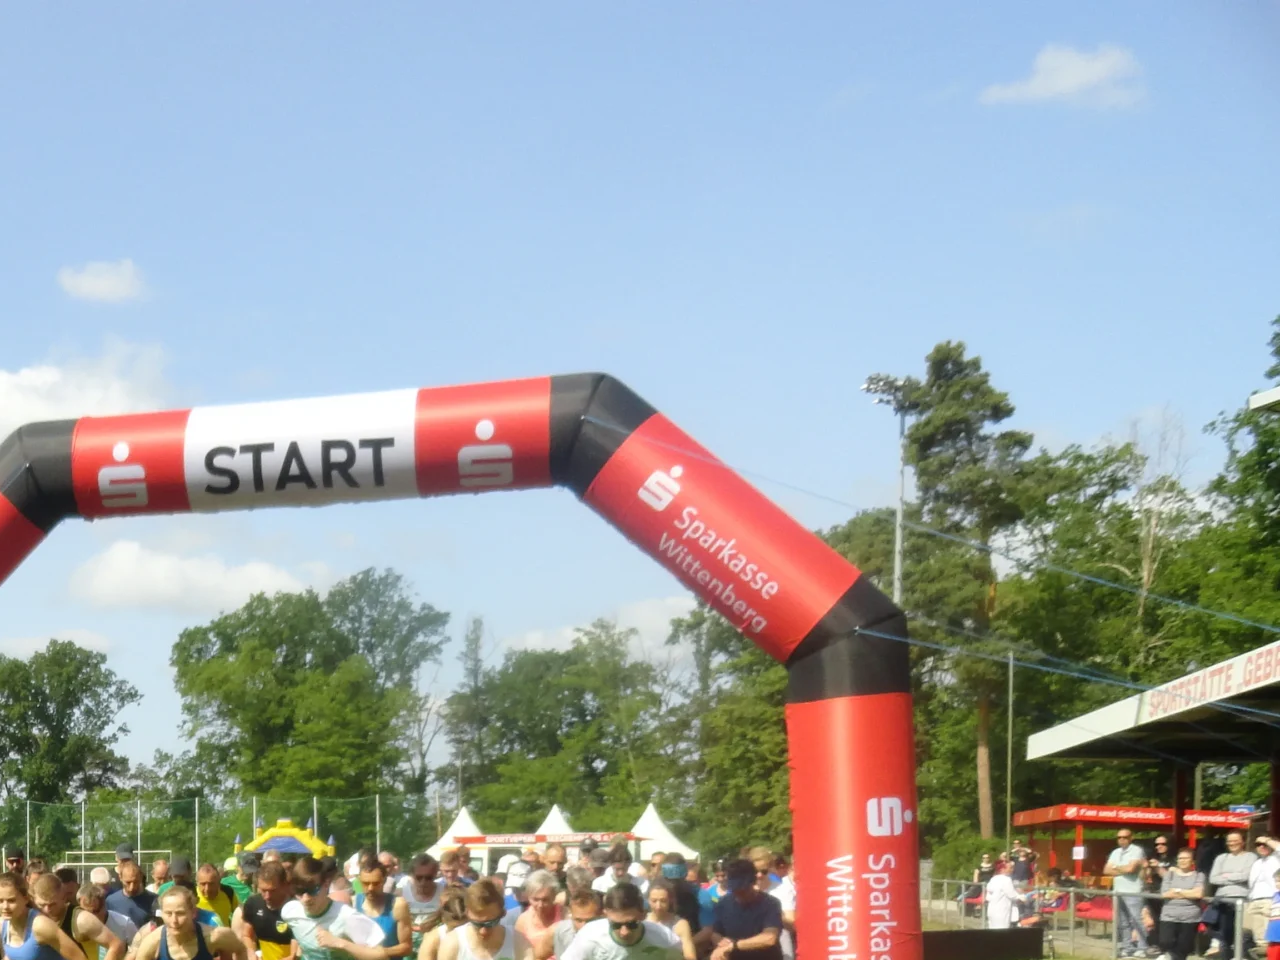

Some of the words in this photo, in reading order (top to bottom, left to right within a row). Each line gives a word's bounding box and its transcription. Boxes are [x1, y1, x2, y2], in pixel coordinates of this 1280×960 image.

[204, 437, 395, 494] START
[658, 530, 768, 635] Wittenberg
[674, 505, 780, 602] Sparkasse
